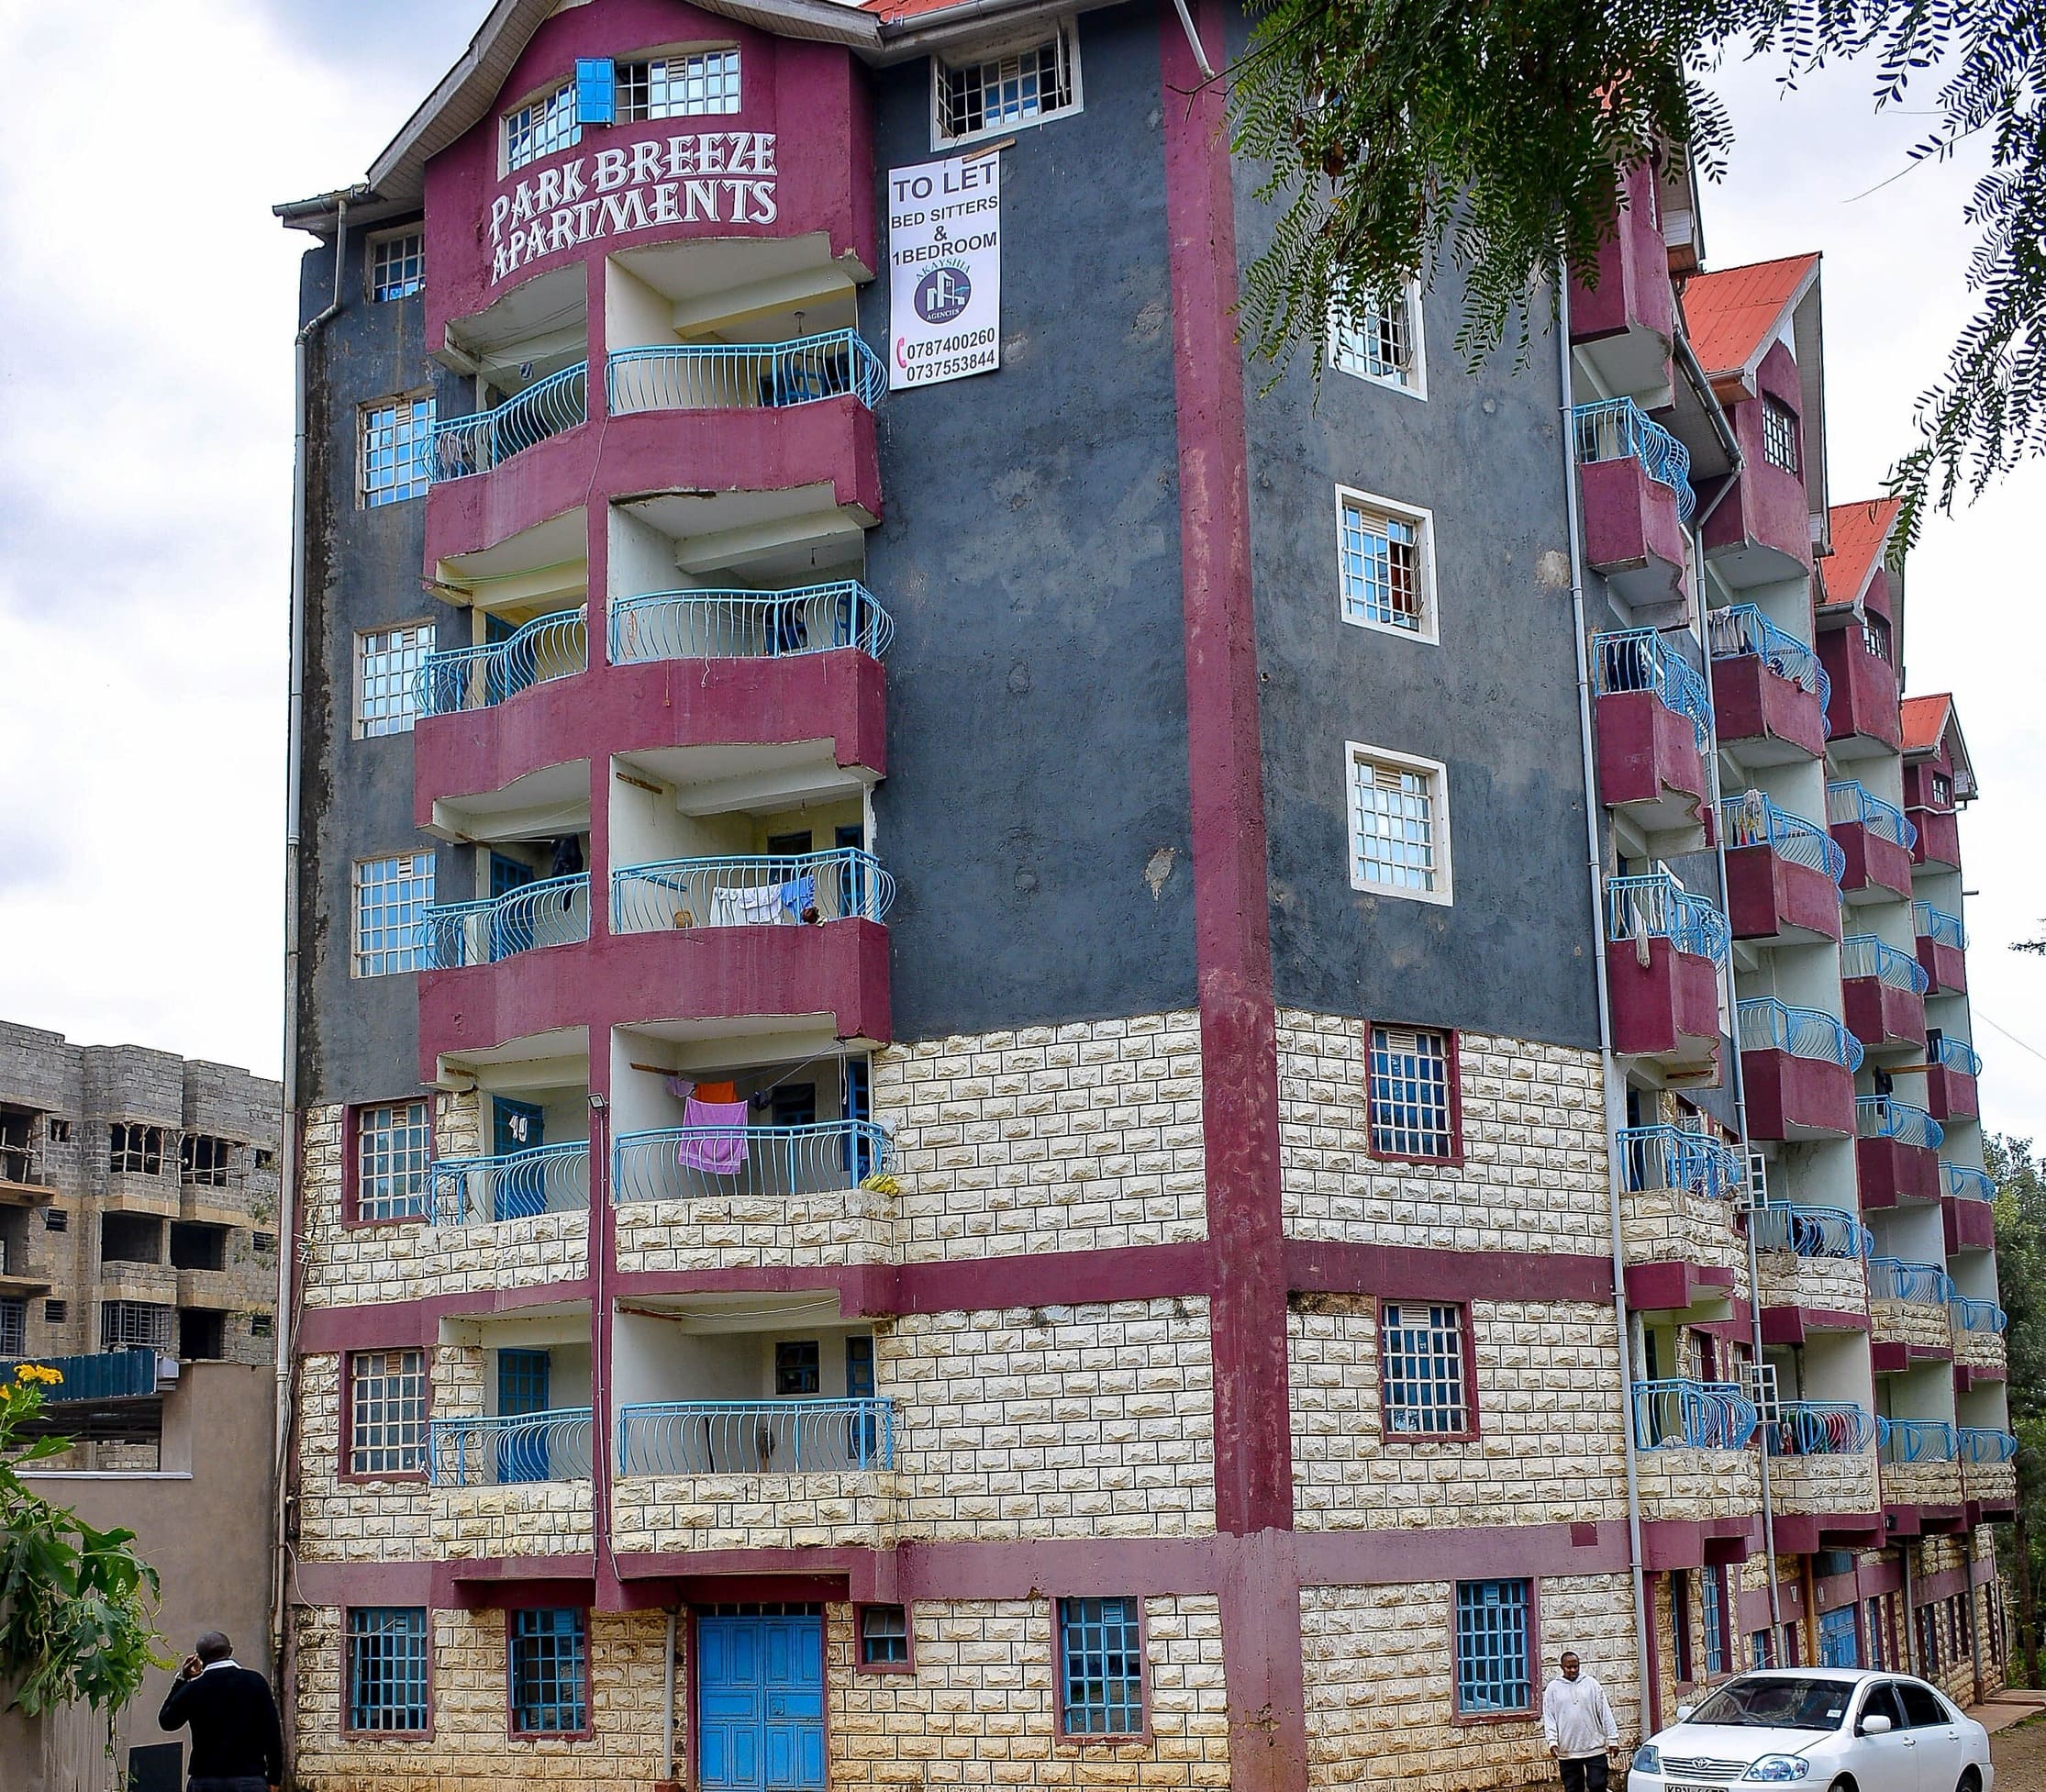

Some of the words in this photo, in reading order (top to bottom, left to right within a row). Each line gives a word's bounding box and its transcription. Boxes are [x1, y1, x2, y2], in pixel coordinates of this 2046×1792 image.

[488, 158, 587, 248] PARK
[592, 132, 778, 194] BREEZE
[893, 177, 933, 202] TO
[943, 161, 997, 195] LET
[891, 212, 925, 229] BED
[930, 195, 998, 222] SITTERS
[491, 179, 778, 287] APARTMENTS
[893, 231, 997, 266] 1BEDROOM
[934, 225, 948, 241] &
[906, 327, 995, 360] 0787400260
[906, 350, 995, 382] 0737553844
